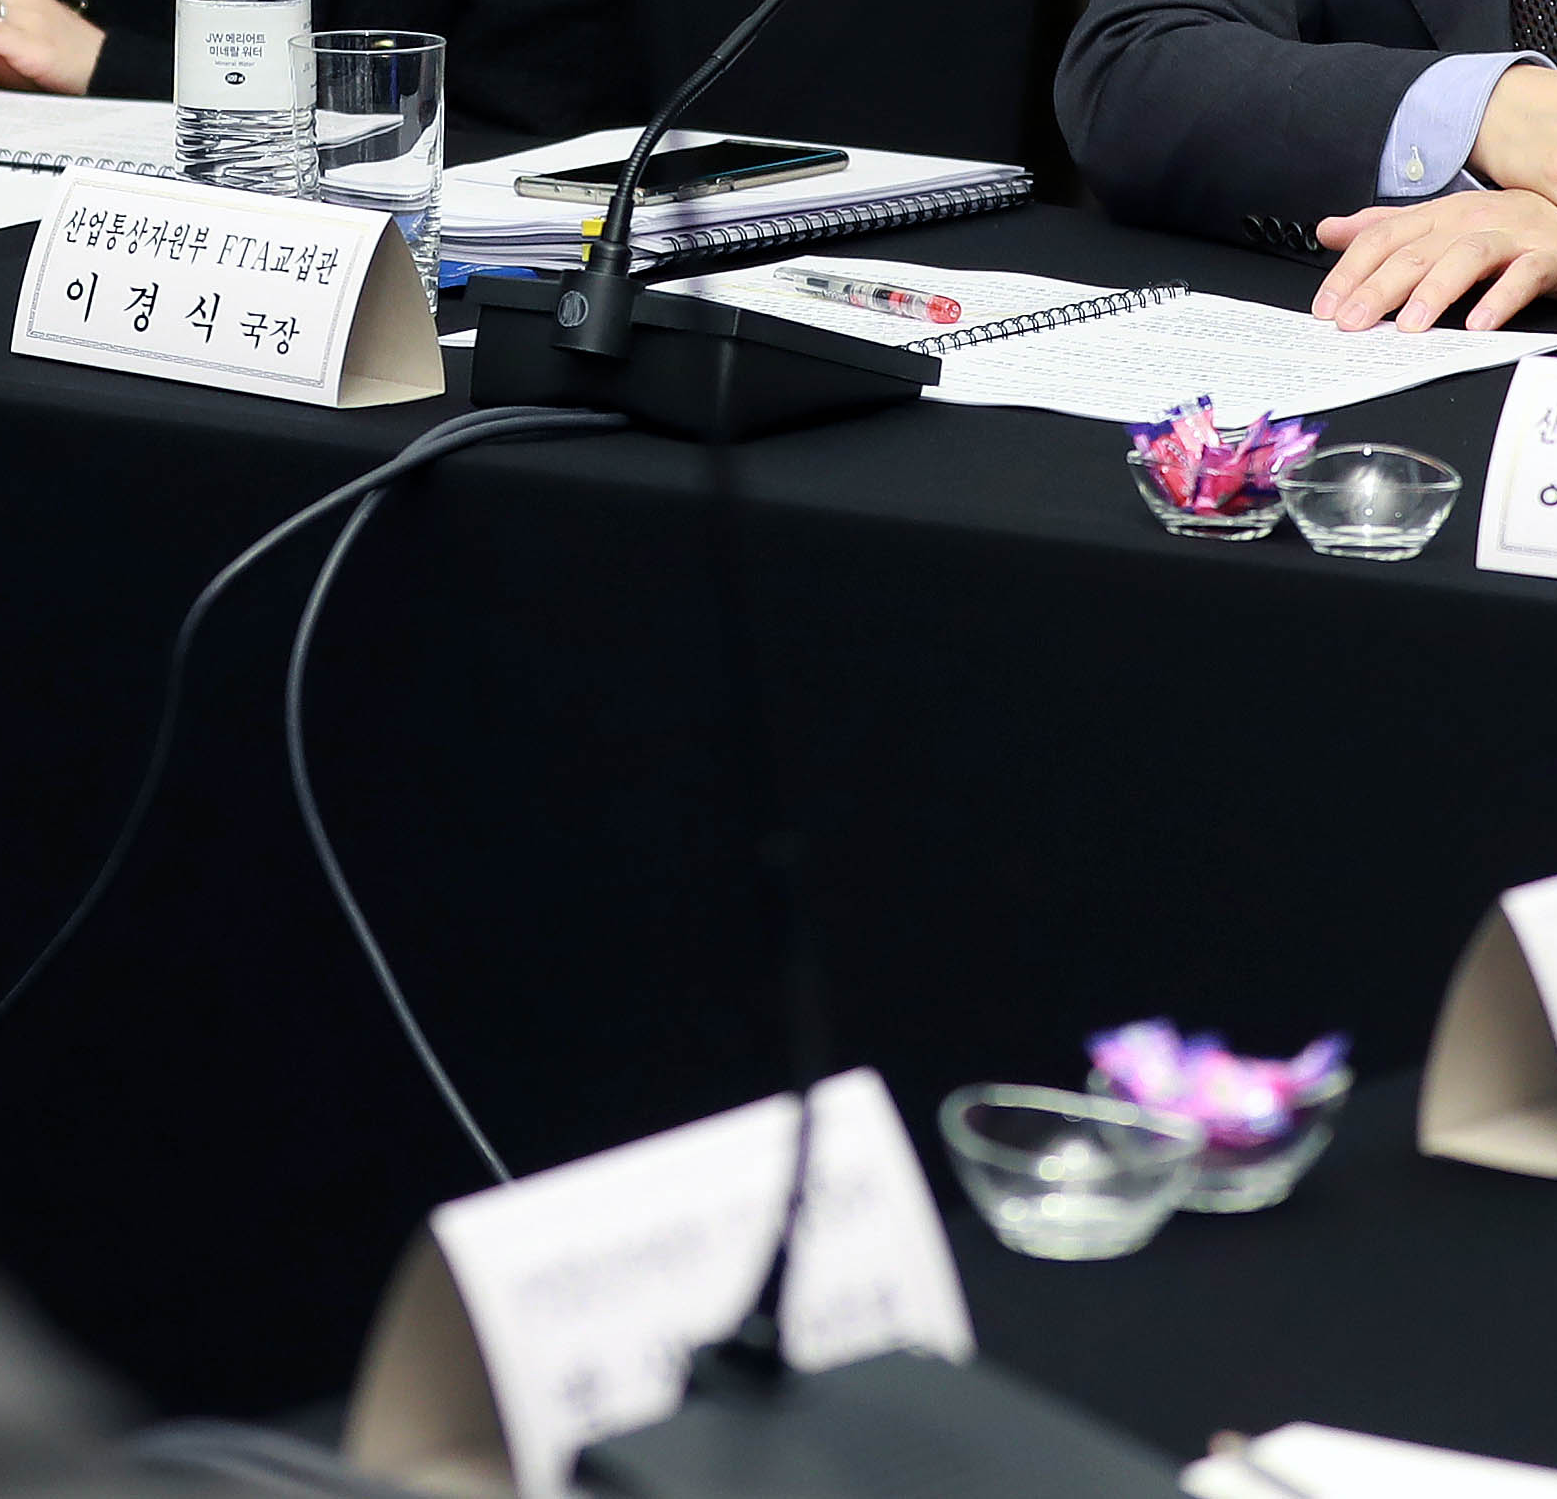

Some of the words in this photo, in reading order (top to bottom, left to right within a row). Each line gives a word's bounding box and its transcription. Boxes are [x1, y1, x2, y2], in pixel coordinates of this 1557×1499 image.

[64, 206, 212, 266] 산업통상자원부
[216, 233, 340, 286] FTA교섭관
[66, 271, 99, 323] 이
[123, 282, 160, 333] 경
[185, 292, 222, 344] 식
[241, 311, 301, 356] 국장
